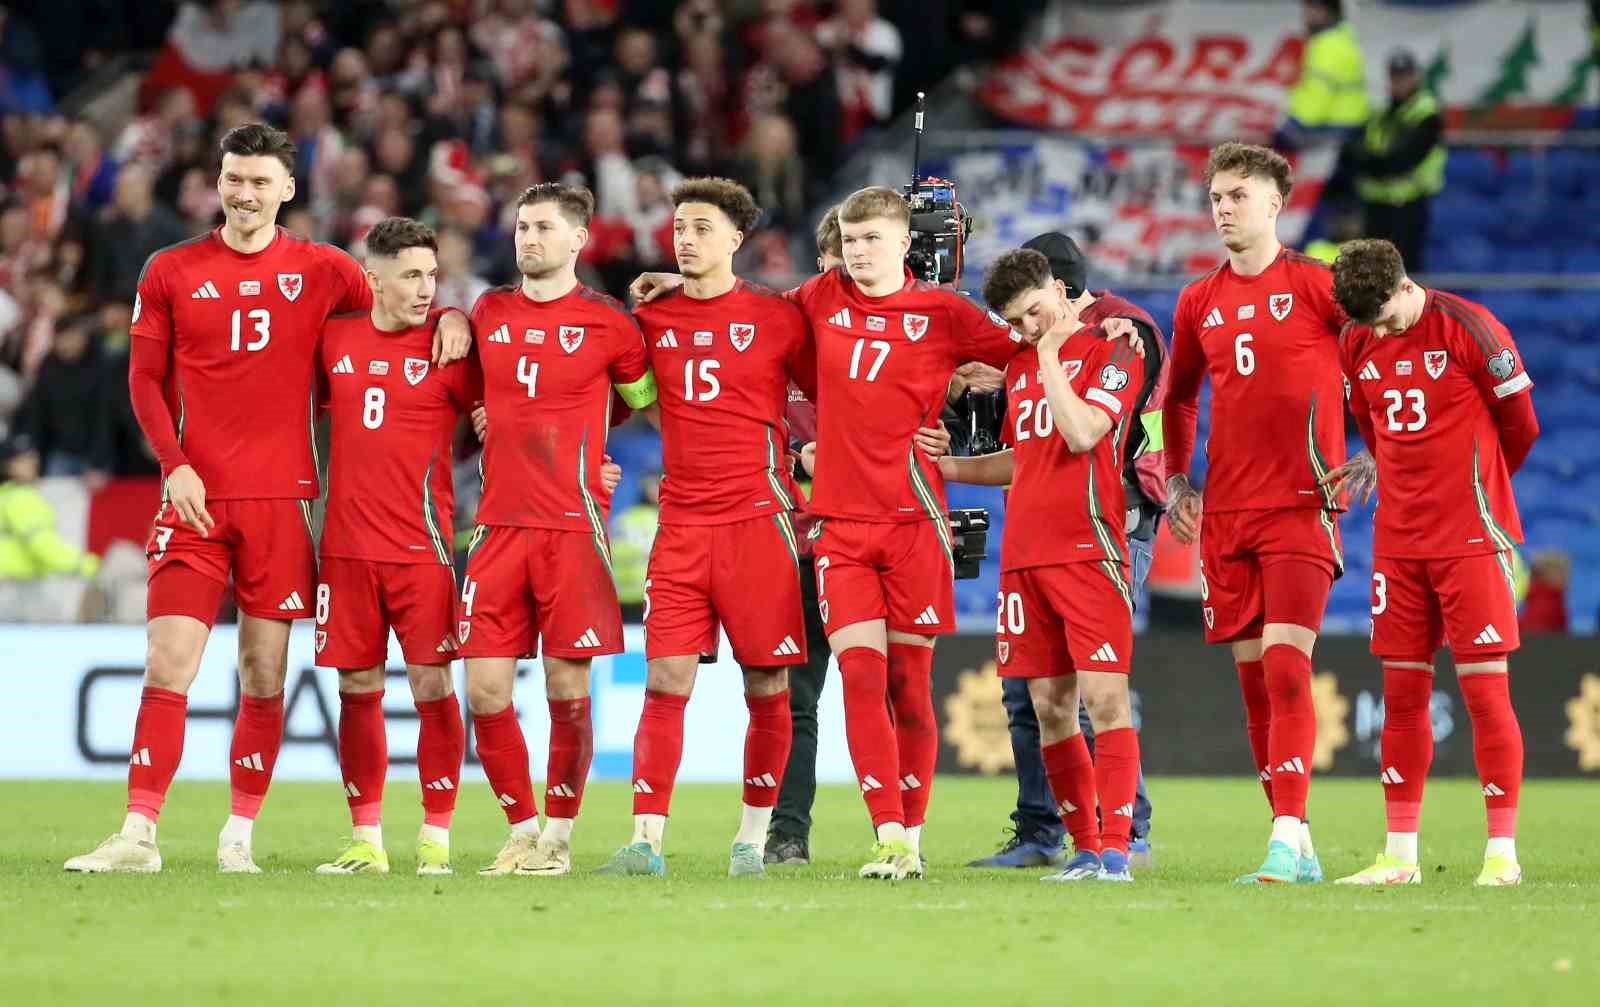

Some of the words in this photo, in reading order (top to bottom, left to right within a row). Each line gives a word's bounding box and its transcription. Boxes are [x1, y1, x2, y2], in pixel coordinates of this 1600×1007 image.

[230, 309, 271, 352] 13
[848, 338, 891, 382] 17
[1234, 333, 1255, 376] 6
[516, 355, 539, 398] 4
[684, 359, 721, 402] 15
[362, 387, 386, 430] 8
[1015, 397, 1053, 441] 20
[1383, 388, 1427, 432] 23
[315, 583, 331, 626] 8
[461, 575, 478, 617] 4
[996, 591, 1025, 635] 20
[1371, 571, 1387, 615] 3
